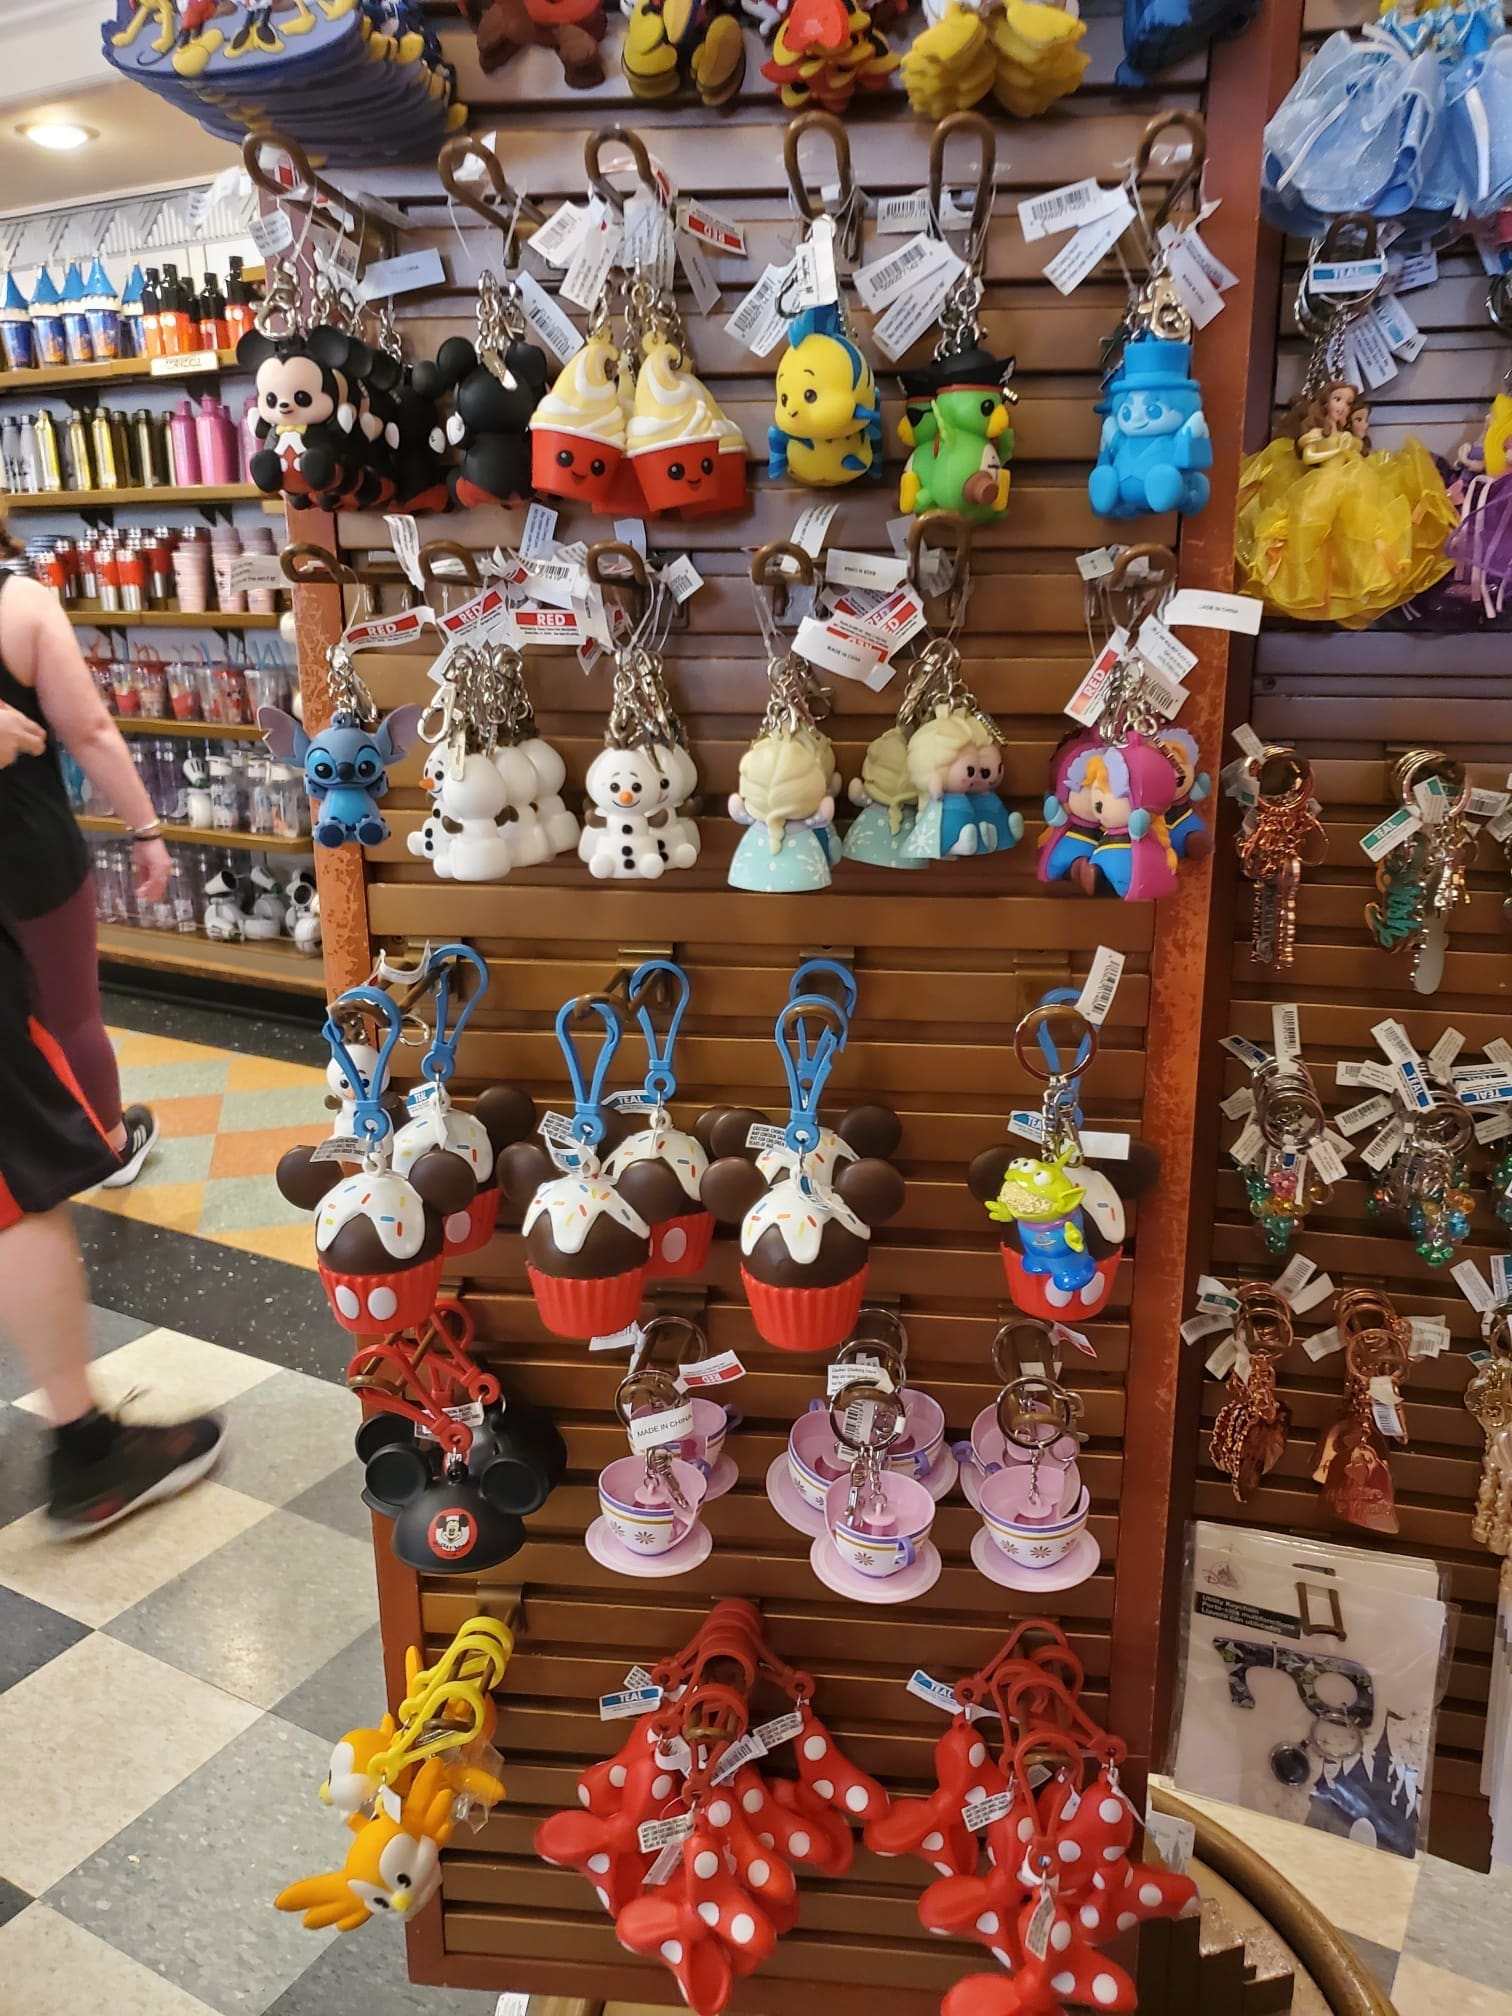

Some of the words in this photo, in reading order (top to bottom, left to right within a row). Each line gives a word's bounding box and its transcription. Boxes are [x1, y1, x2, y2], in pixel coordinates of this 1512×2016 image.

[457, 604, 483, 625] RED
[536, 613, 566, 627] RED
[366, 622, 397, 636] RED
[1083, 669, 1106, 697] RED
[1373, 820, 1396, 840] TEAL
[1406, 1073, 1422, 1097] TEAL
[619, 1094, 645, 1105] TEAL
[1476, 1088, 1501, 1101] TEAL
[1027, 1115, 1042, 1130] TEA
[702, 1373, 722, 1383] RED
[637, 1425, 659, 1438] MADE
[659, 1422, 669, 1430] IN
[669, 1413, 693, 1429] CHINA
[1225, 1600, 1259, 1615] Keychain
[619, 1691, 644, 1703] TEAL
